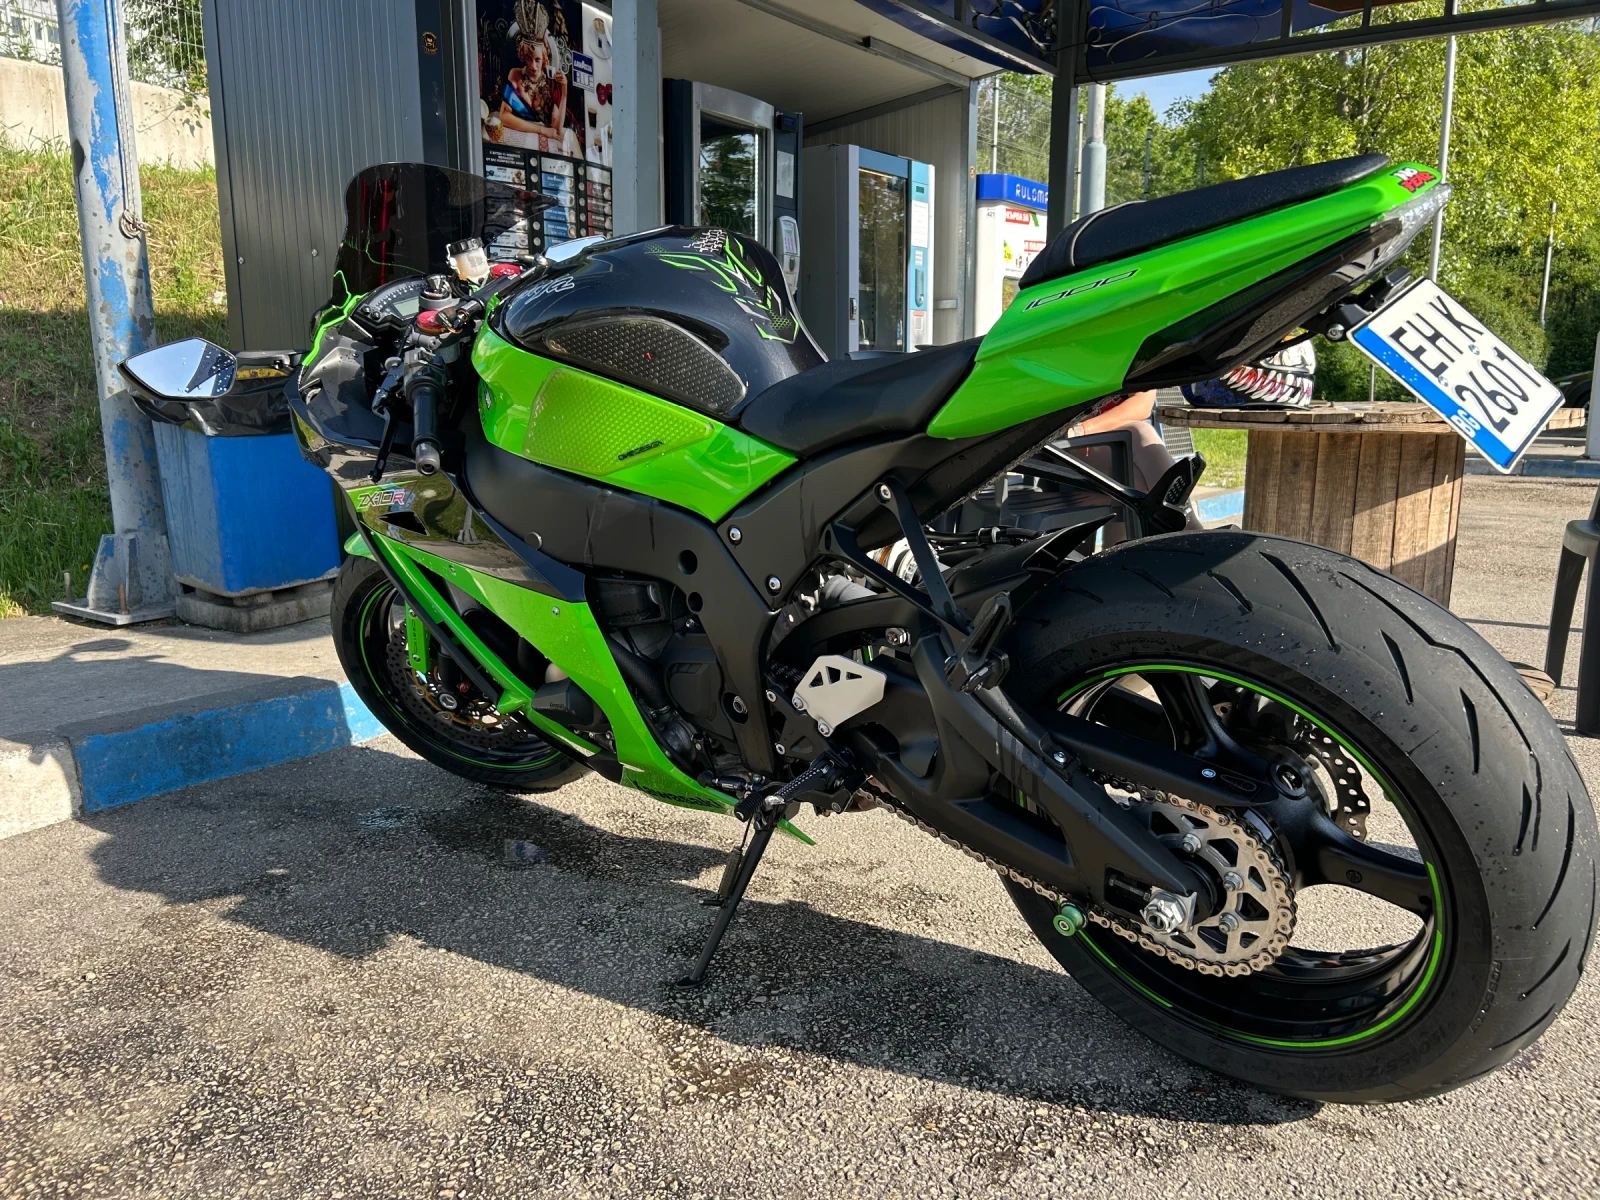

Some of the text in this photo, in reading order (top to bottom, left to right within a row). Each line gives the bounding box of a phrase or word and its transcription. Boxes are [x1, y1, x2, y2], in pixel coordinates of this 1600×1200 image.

[1389, 295, 1484, 377] EHK
[1451, 409, 1482, 438] BG
[1454, 346, 1542, 434] 2601
